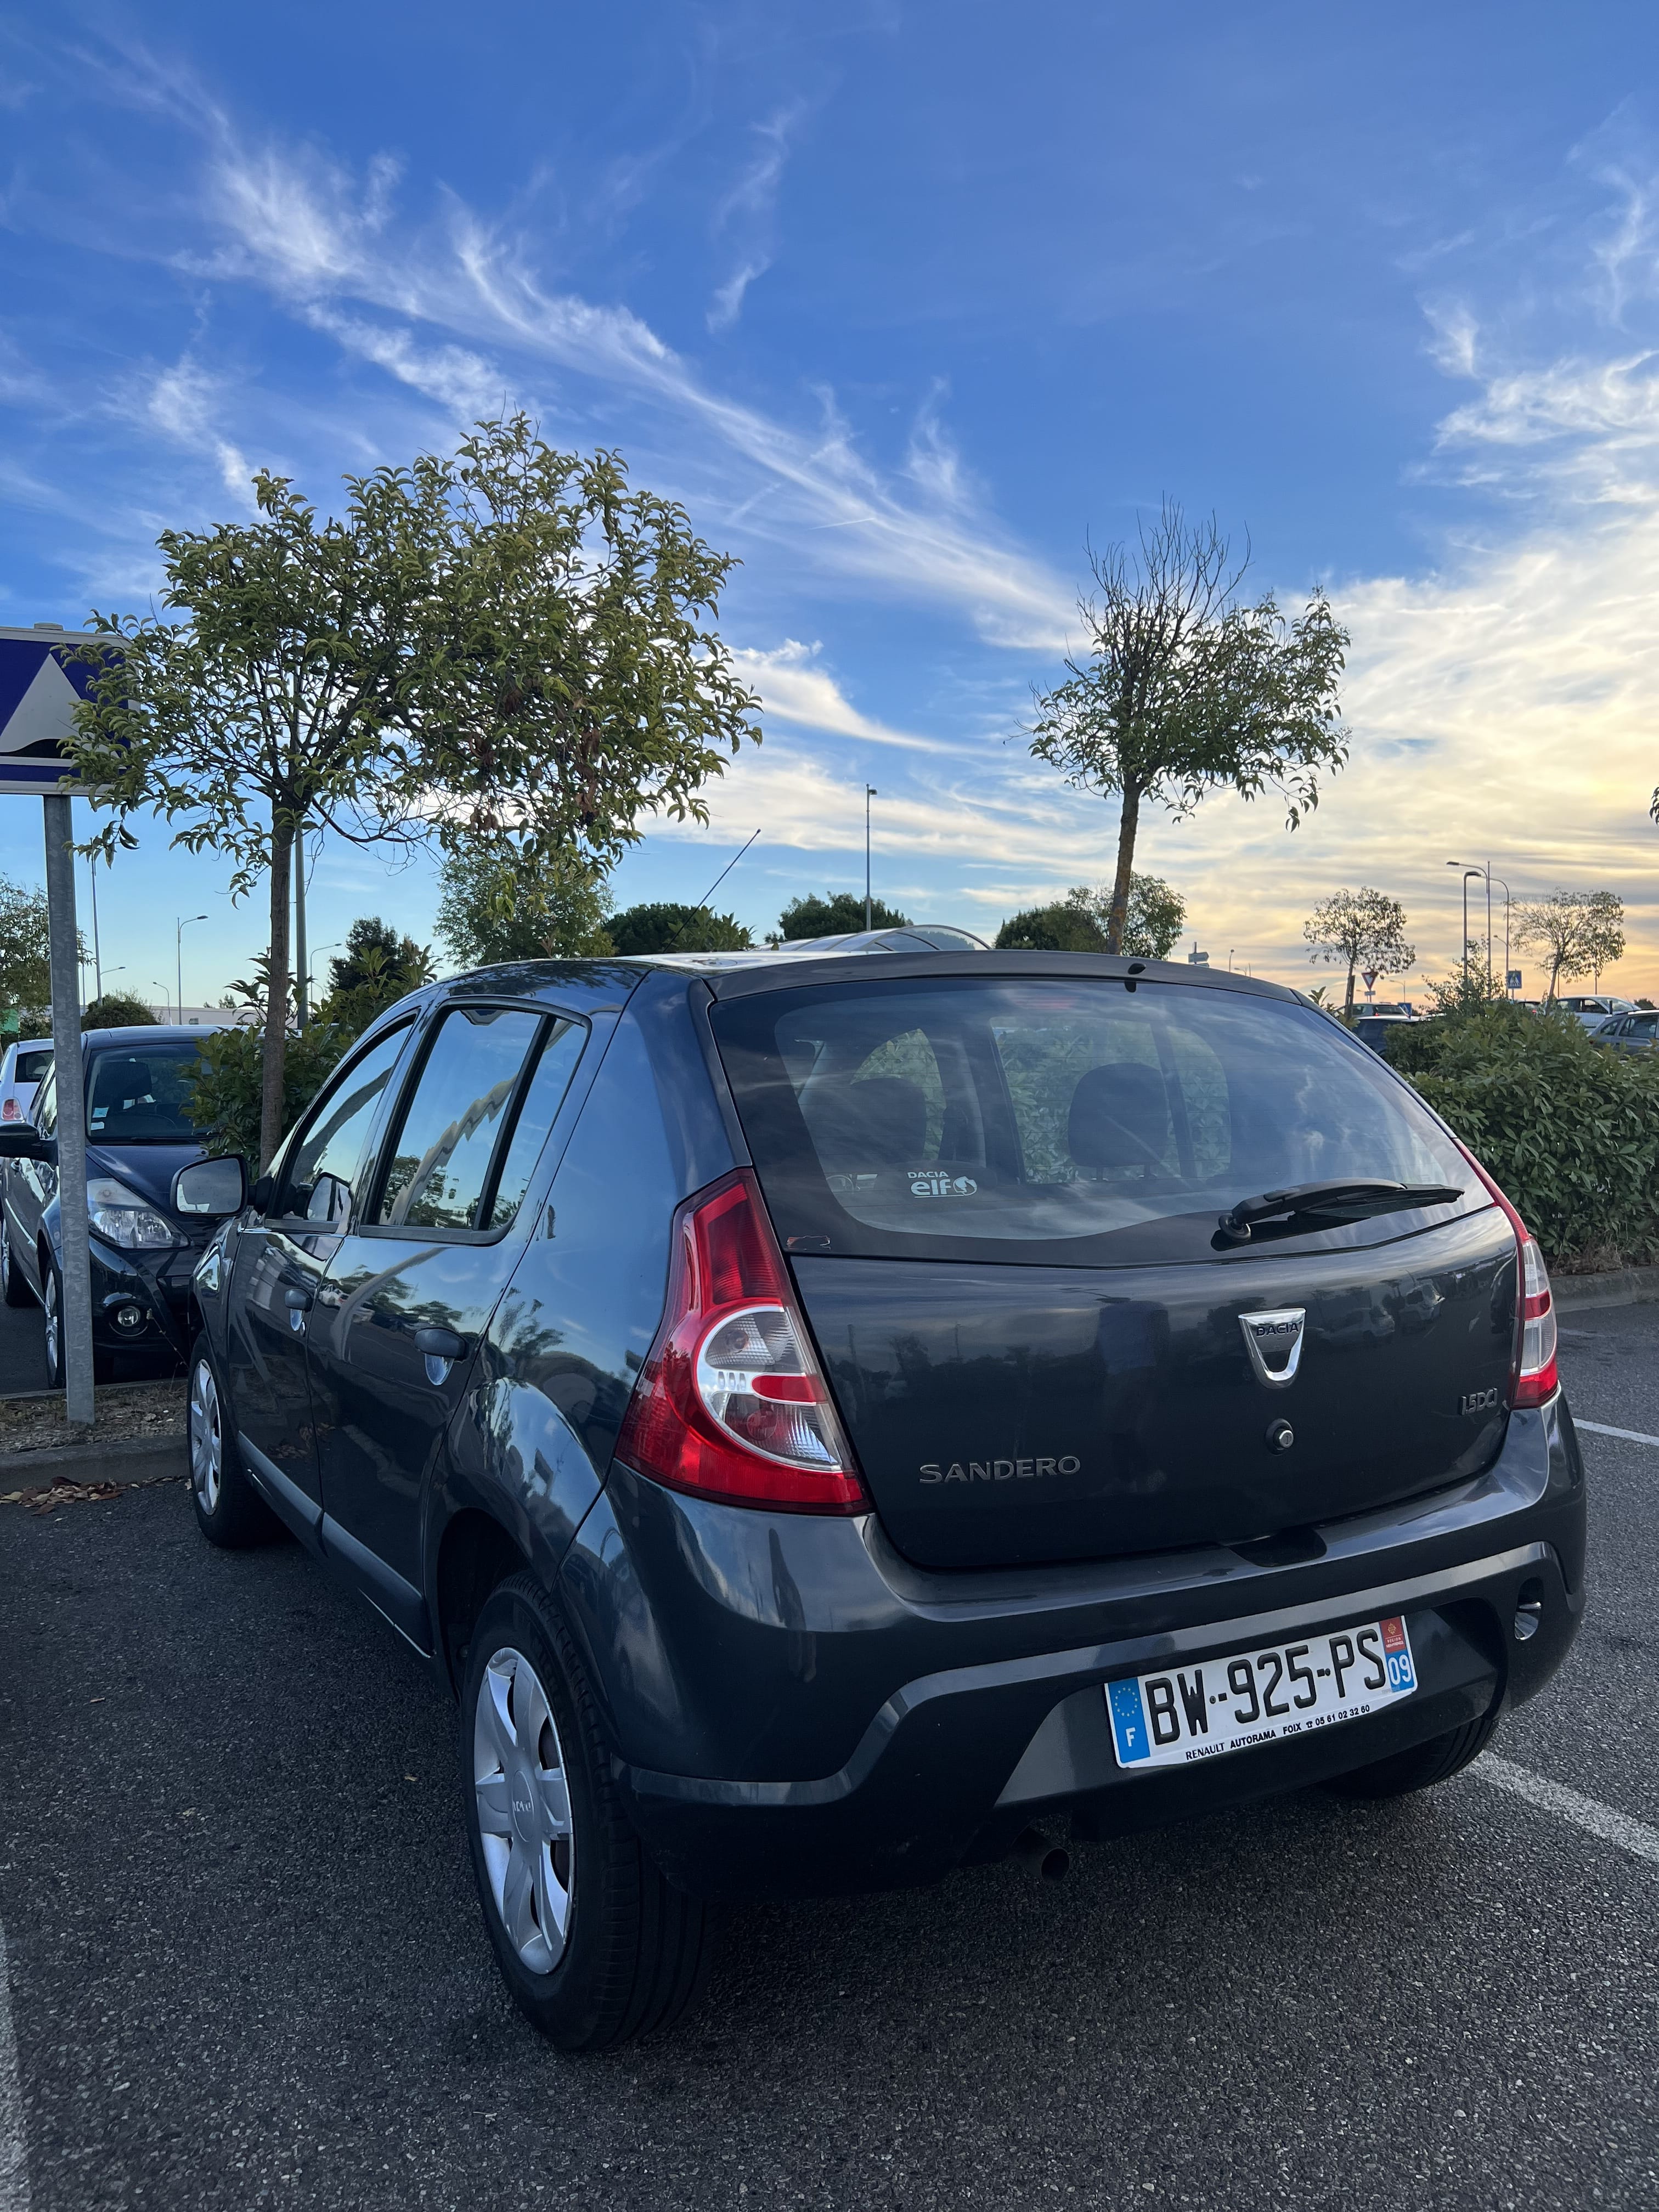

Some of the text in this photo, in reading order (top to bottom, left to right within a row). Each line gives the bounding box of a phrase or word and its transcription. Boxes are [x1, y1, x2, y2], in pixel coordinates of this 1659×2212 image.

[907, 1170, 949, 1179] DACIA
[910, 1178, 951, 1196] elf
[1256, 1323, 1299, 1337] DACIA
[919, 1455, 1081, 1484] SANDERO
[1388, 1654, 1412, 1685] 09
[1145, 1629, 1386, 1746] BW-925-PS
[1126, 1727, 1136, 1747] F
[1186, 1742, 1225, 1760] RENAULT
[1230, 1730, 1277, 1749] AUTORAMA
[1283, 1723, 1302, 1735] FOIX
[1316, 1717, 1325, 1726] 05
[1338, 1711, 1348, 1720] 02
